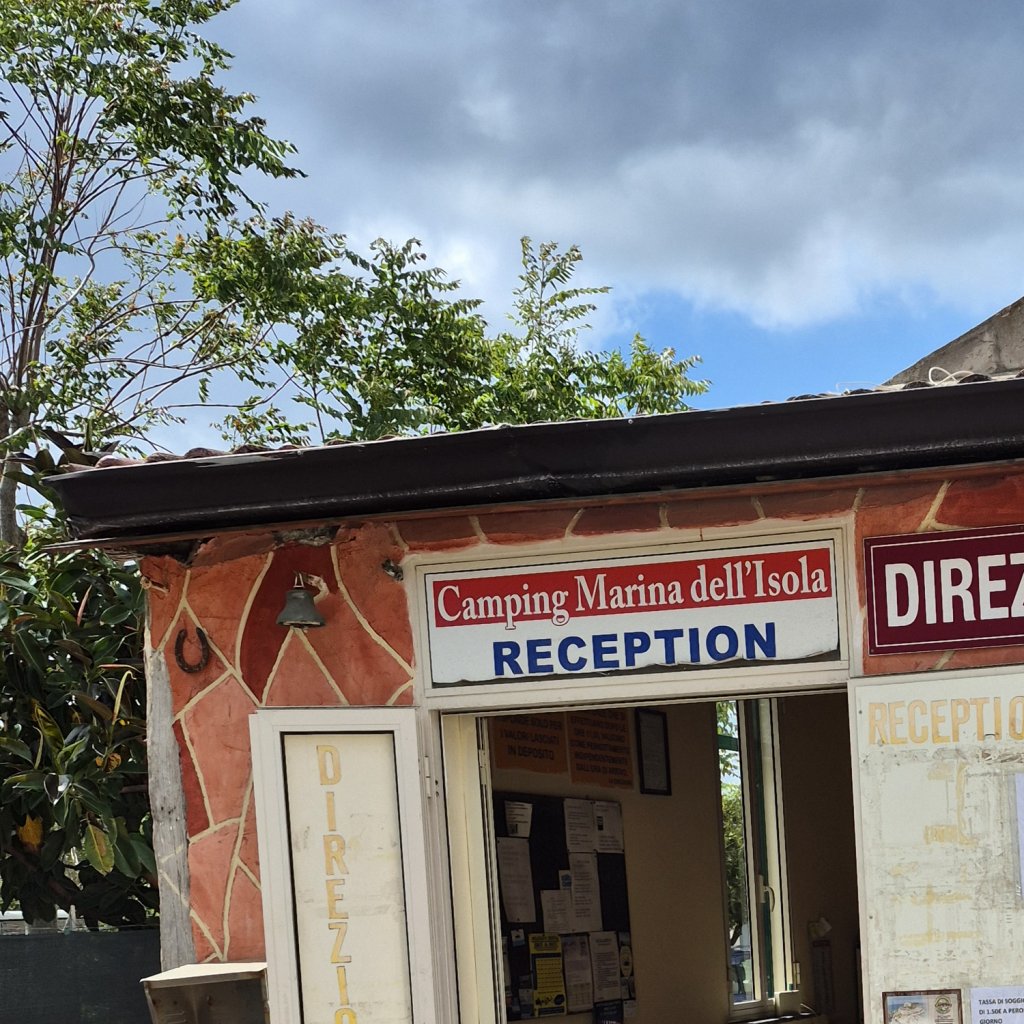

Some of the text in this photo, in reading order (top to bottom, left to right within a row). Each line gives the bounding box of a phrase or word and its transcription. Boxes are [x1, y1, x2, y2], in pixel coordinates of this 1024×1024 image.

[437, 555, 828, 630] Camping Marina dell'Isola
[493, 622, 776, 676] RECEPTION
